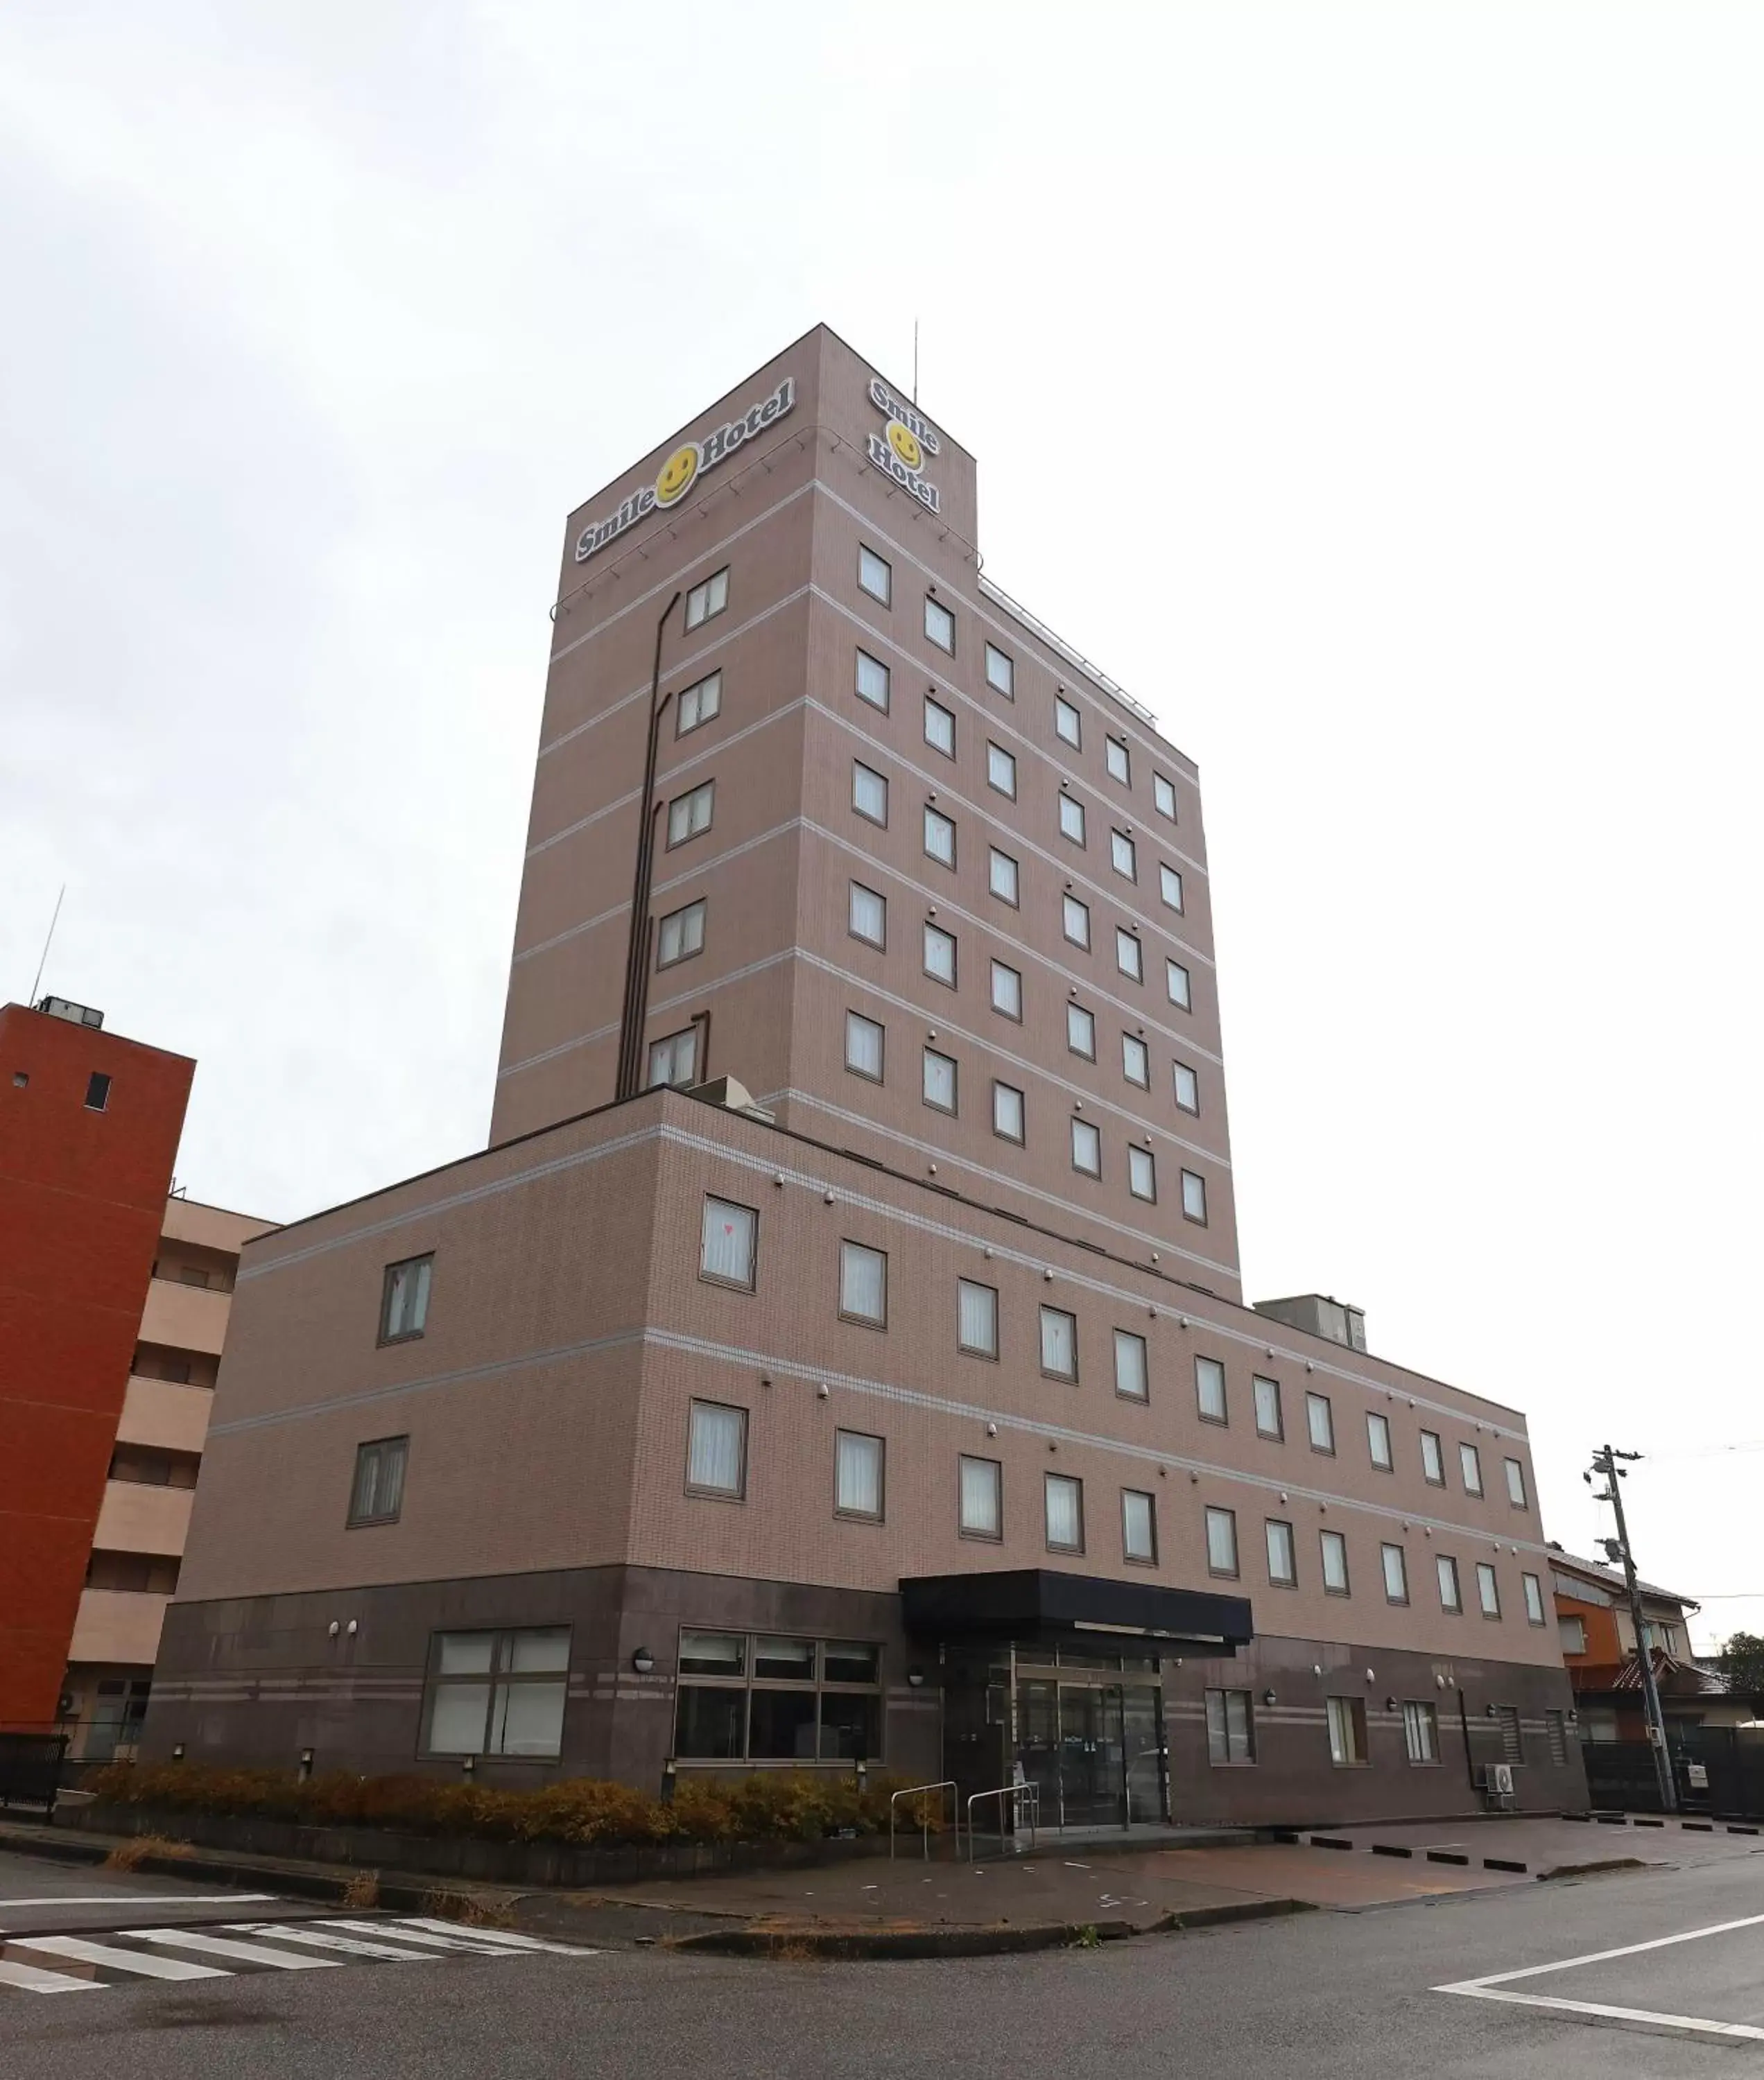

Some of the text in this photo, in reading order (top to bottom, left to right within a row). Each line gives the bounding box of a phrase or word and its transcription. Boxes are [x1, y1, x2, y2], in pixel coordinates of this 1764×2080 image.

[872, 381, 940, 451] Smile
[577, 380, 793, 557] Smile Hotel
[870, 436, 938, 509] Hotel
